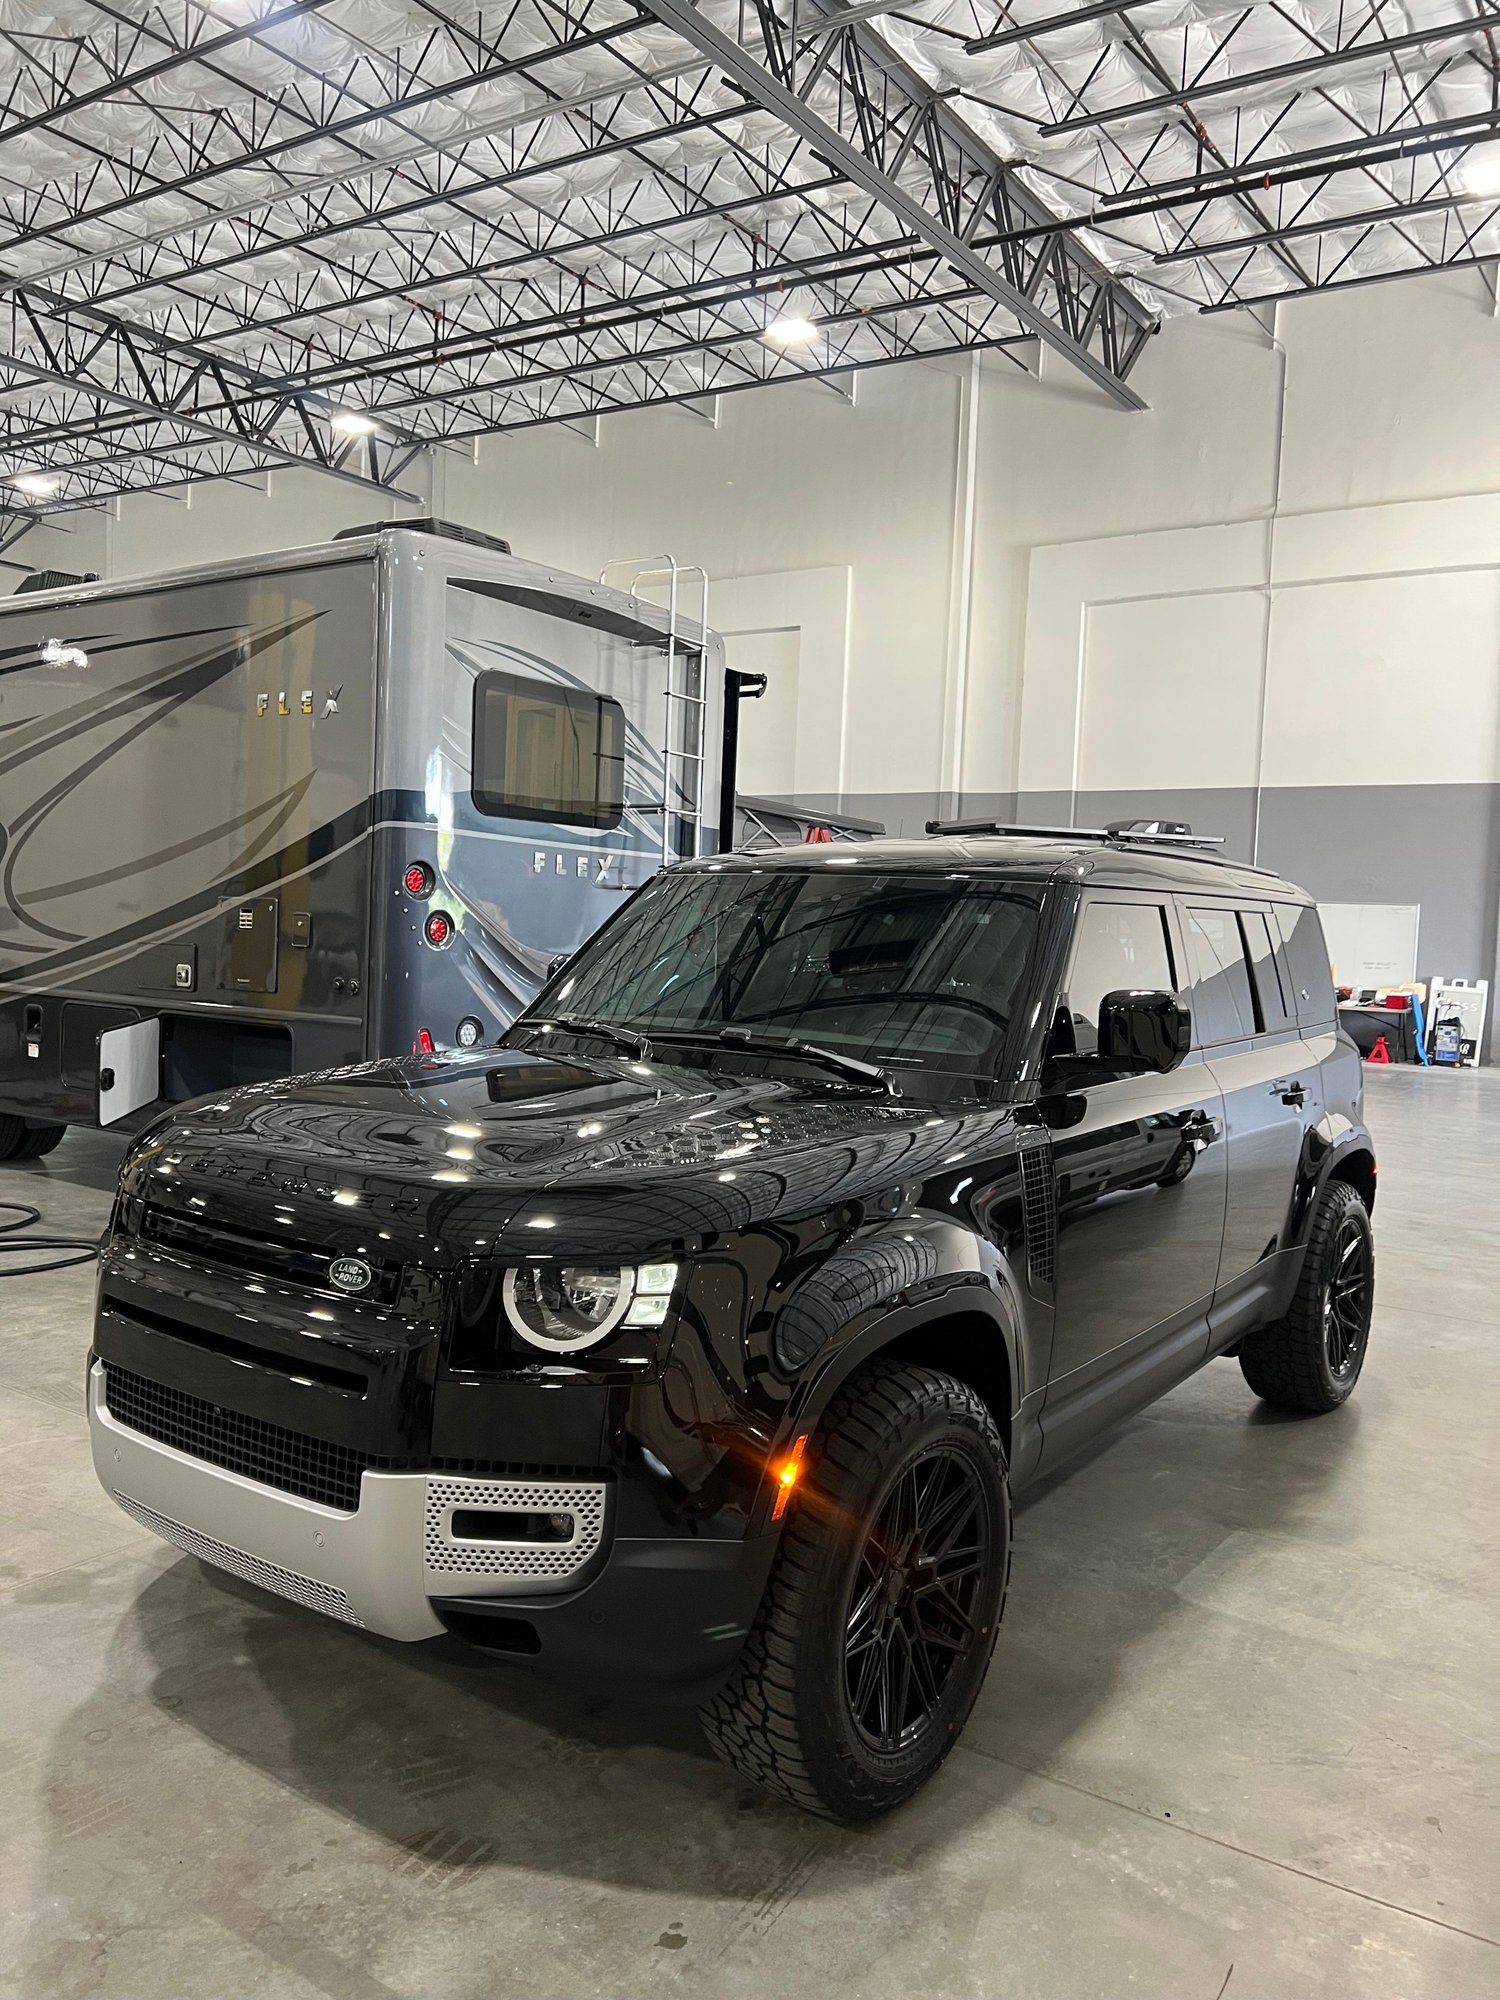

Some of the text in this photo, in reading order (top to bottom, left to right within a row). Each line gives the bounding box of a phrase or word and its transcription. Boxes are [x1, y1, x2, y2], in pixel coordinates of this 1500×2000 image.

[256, 683, 344, 720] FLEX
[533, 851, 614, 886] FLEX
[164, 1149, 421, 1218] DEFENDER
[338, 1263, 359, 1275] LAND
[338, 1272, 363, 1285] ROVER
